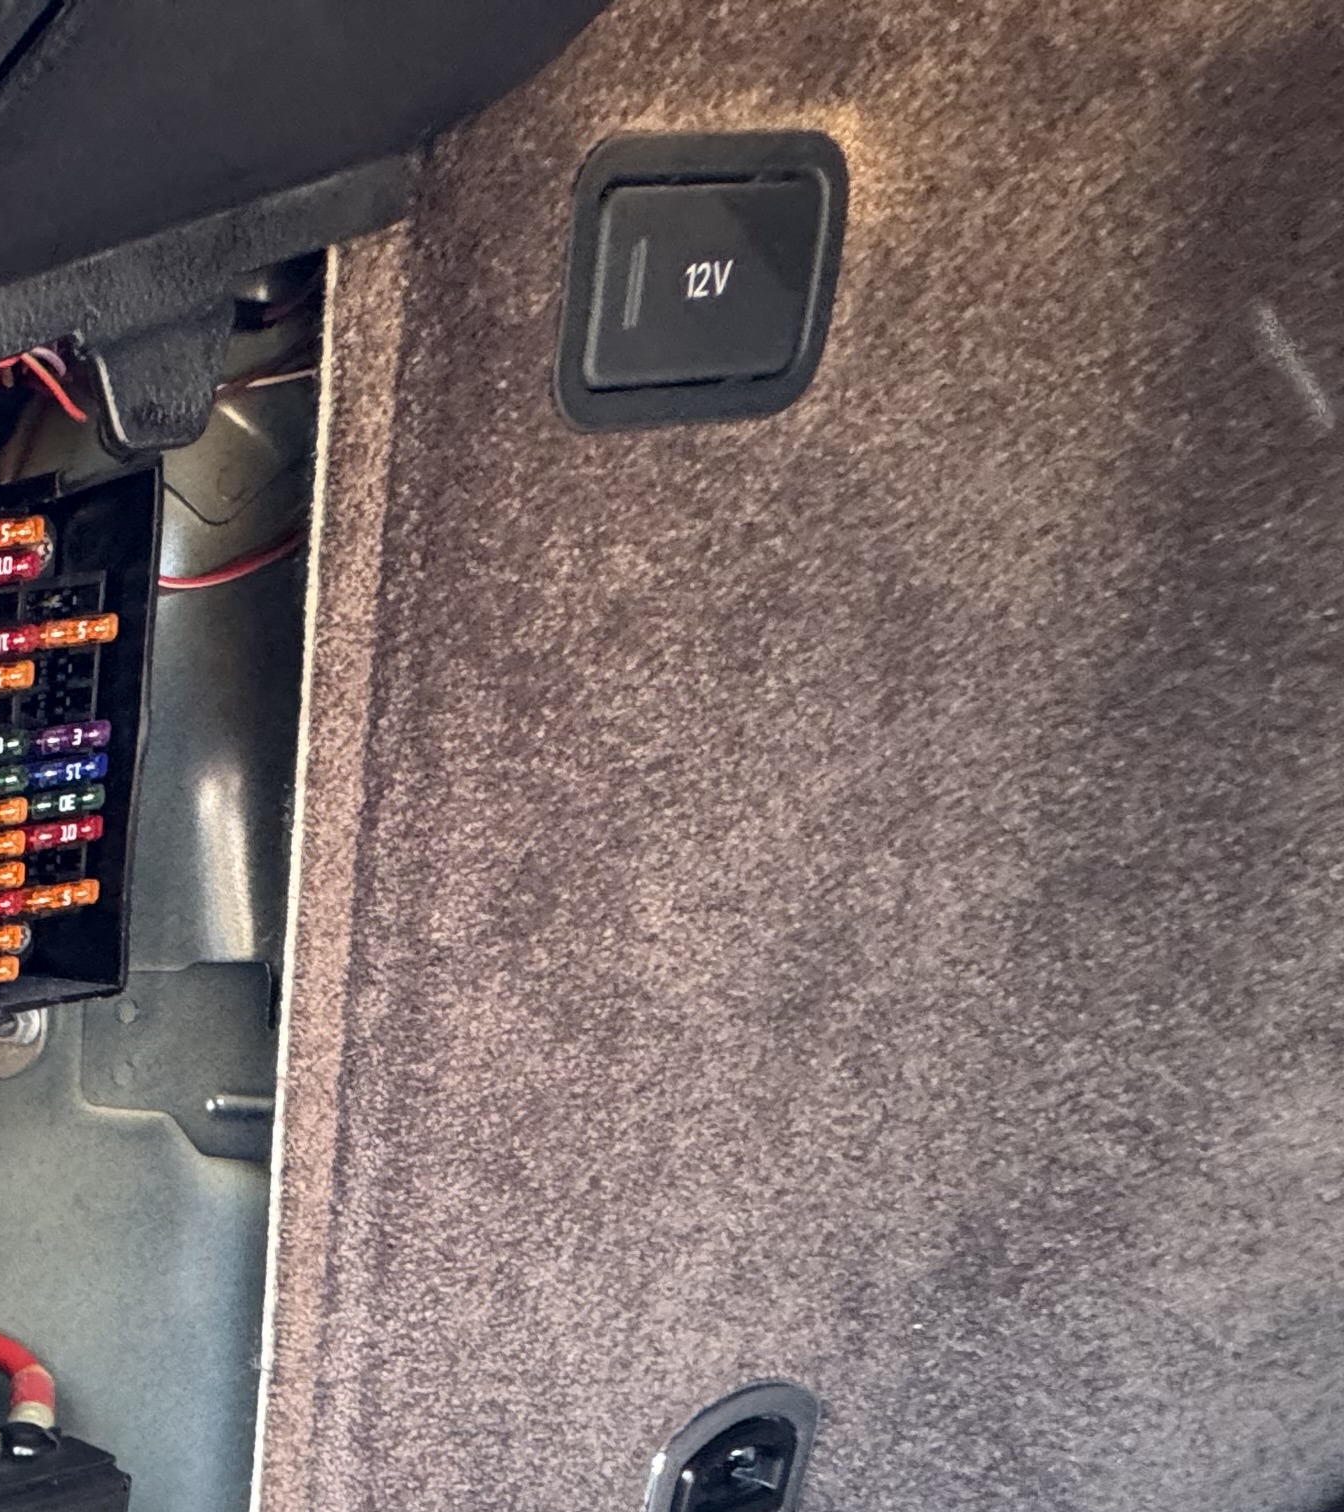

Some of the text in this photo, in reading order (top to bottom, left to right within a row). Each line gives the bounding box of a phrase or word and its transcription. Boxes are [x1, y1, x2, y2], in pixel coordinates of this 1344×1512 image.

[684, 259, 734, 299] 12V
[1, 524, 10, 542] 5
[77, 622, 87, 639] 5
[72, 728, 82, 746] 3
[65, 762, 82, 779] 15
[58, 794, 76, 811] 30
[60, 823, 77, 841] 10
[62, 889, 71, 906] 5
